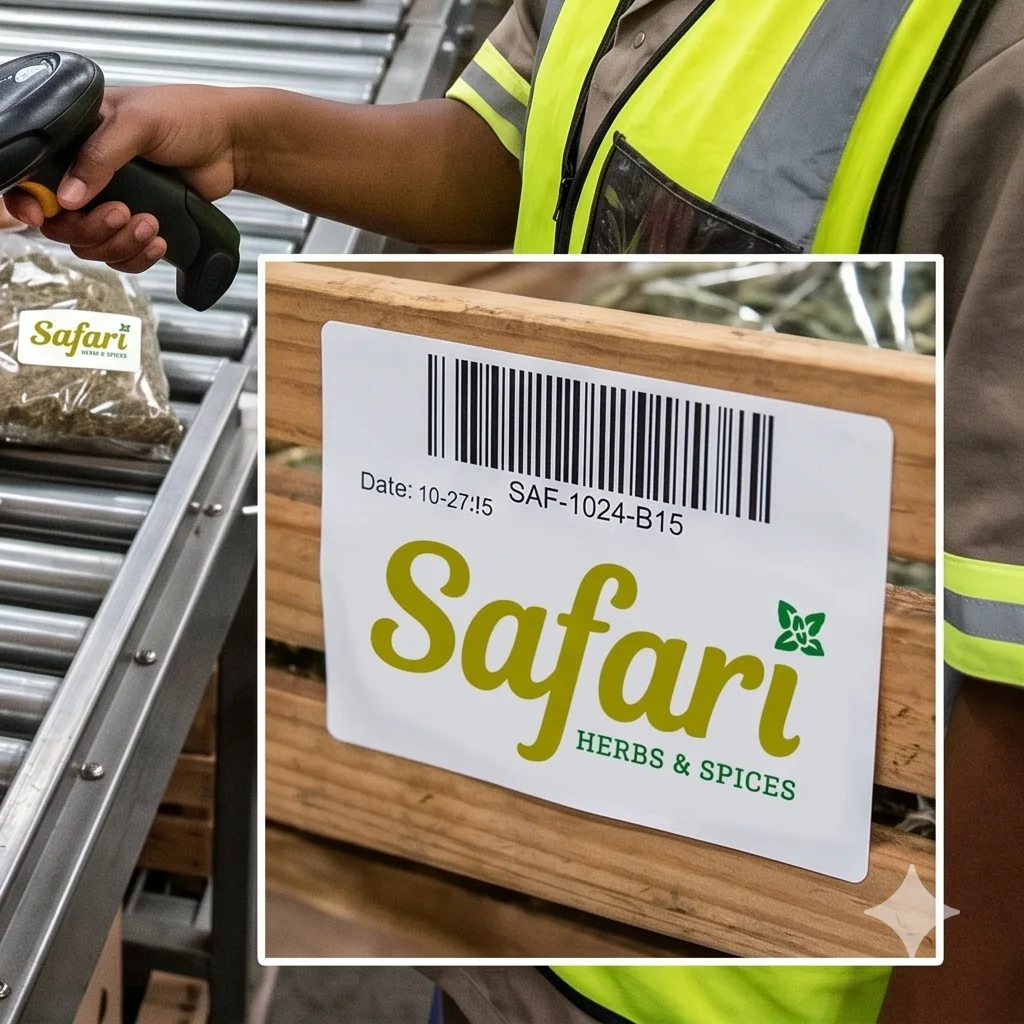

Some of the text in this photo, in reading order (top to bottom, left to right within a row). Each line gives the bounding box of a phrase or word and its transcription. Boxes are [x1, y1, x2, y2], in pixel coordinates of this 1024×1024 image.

[30, 320, 128, 357] Safari
[361, 471, 413, 499] Date:
[509, 481, 684, 536] SAF-1024-B15
[370, 539, 802, 763] Safari
[576, 730, 796, 801] HERBS & SPICES
